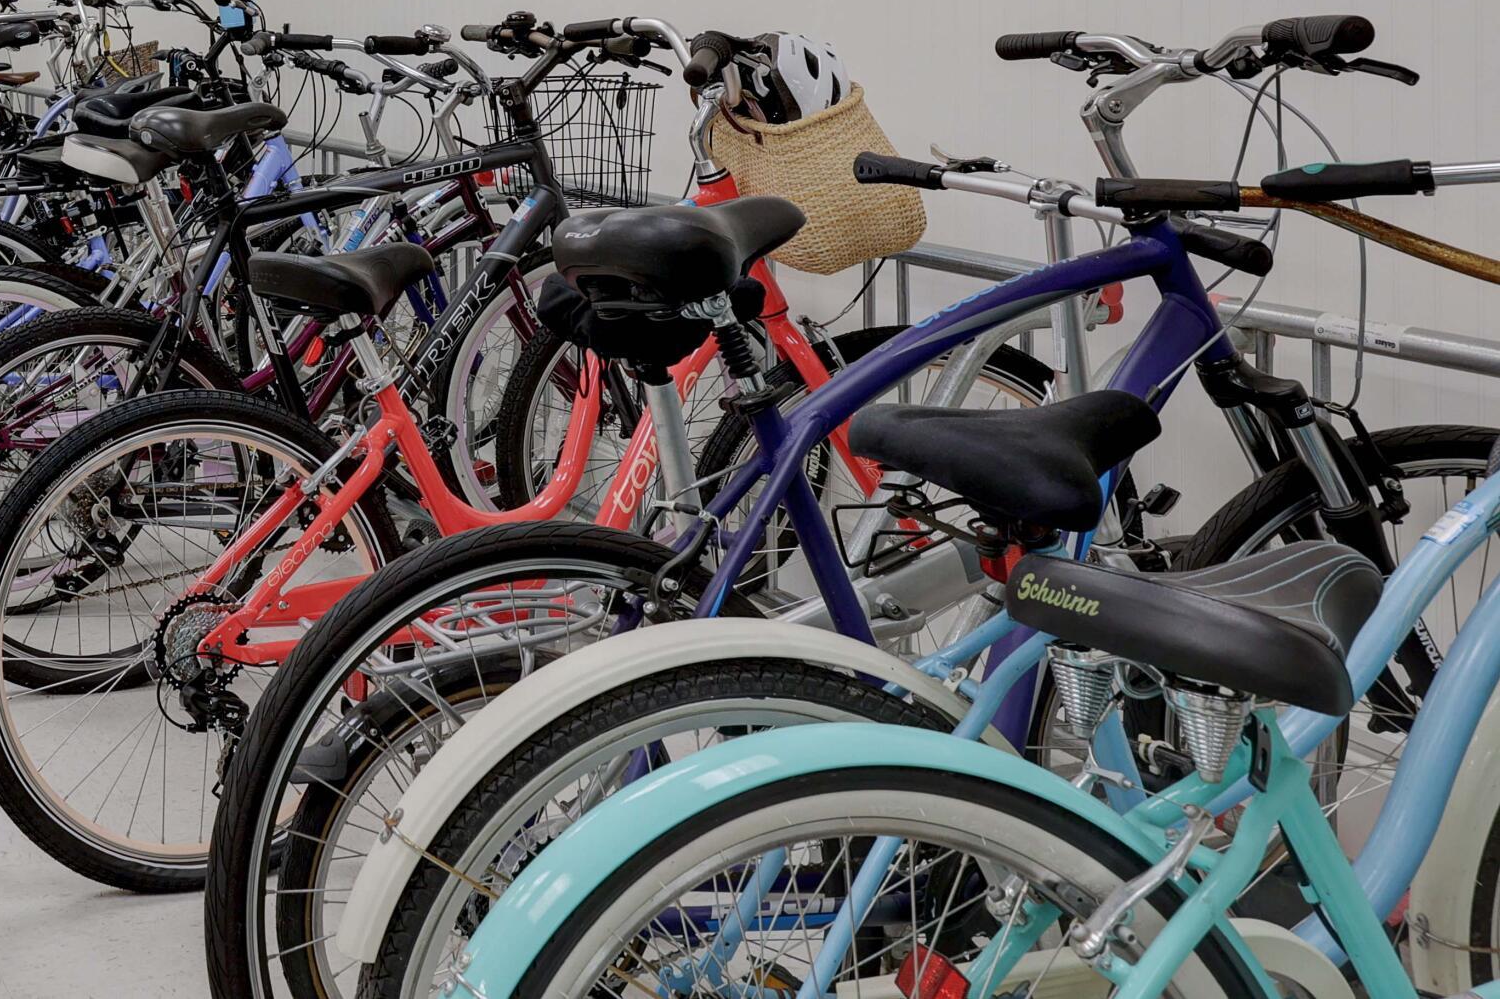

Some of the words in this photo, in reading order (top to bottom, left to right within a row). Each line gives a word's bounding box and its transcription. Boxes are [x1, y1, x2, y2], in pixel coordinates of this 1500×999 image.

[403, 157, 482, 184] 4300
[398, 270, 497, 405] TREK
[267, 520, 334, 587] electra
[1017, 572, 1100, 617] Schwinn
